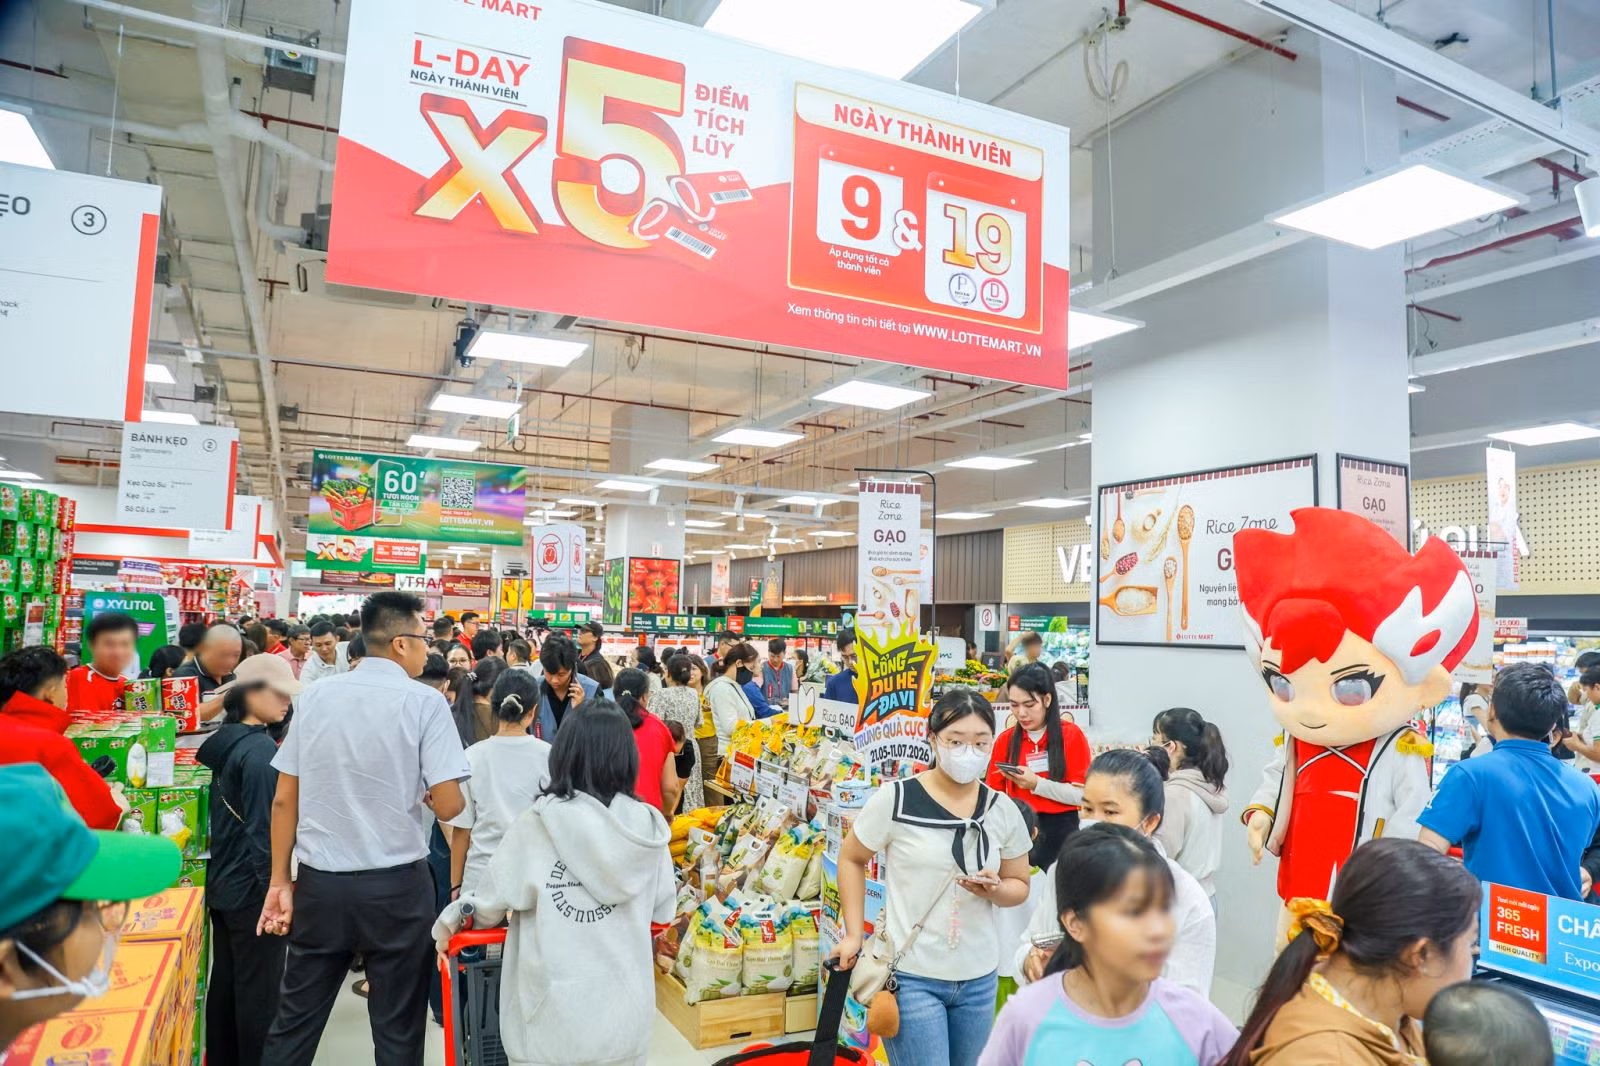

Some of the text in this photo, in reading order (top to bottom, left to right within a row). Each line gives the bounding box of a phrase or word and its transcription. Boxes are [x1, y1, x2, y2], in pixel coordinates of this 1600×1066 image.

[413, 39, 530, 87] L-DAY
[410, 69, 519, 100] NGÀY THÀNH VIÊN
[695, 83, 749, 112] ĐIỂM
[694, 108, 745, 136] TÍCH
[834, 103, 1012, 168] NGÀY THÀNH VIÊN
[692, 133, 735, 160] LŨY
[82, 212, 96, 228] 3
[841, 174, 1012, 276] 9 & 19
[837, 259, 881, 276] thành viên
[787, 302, 1042, 357] Xem thông tin chi tiết tại WWW.LOTTEMART.VN
[165, 436, 188, 448] KẸO
[880, 499, 901, 510] Rice
[1362, 496, 1386, 514] GẠO
[878, 510, 902, 521] Zone
[1206, 519, 1236, 535] Rice
[874, 529, 907, 547] GẠO
[1199, 583, 1227, 595] Nguyên
[106, 599, 156, 611] XYLITOL
[1206, 598, 1227, 608] mang
[867, 648, 910, 681] CỔNG
[871, 666, 918, 700] DU HÈ
[822, 708, 856, 730] Rice GẠO
[1497, 906, 1521, 922] 365
[1496, 920, 1540, 942] FRESH
[1496, 944, 1540, 960] HIGH QUALITY
